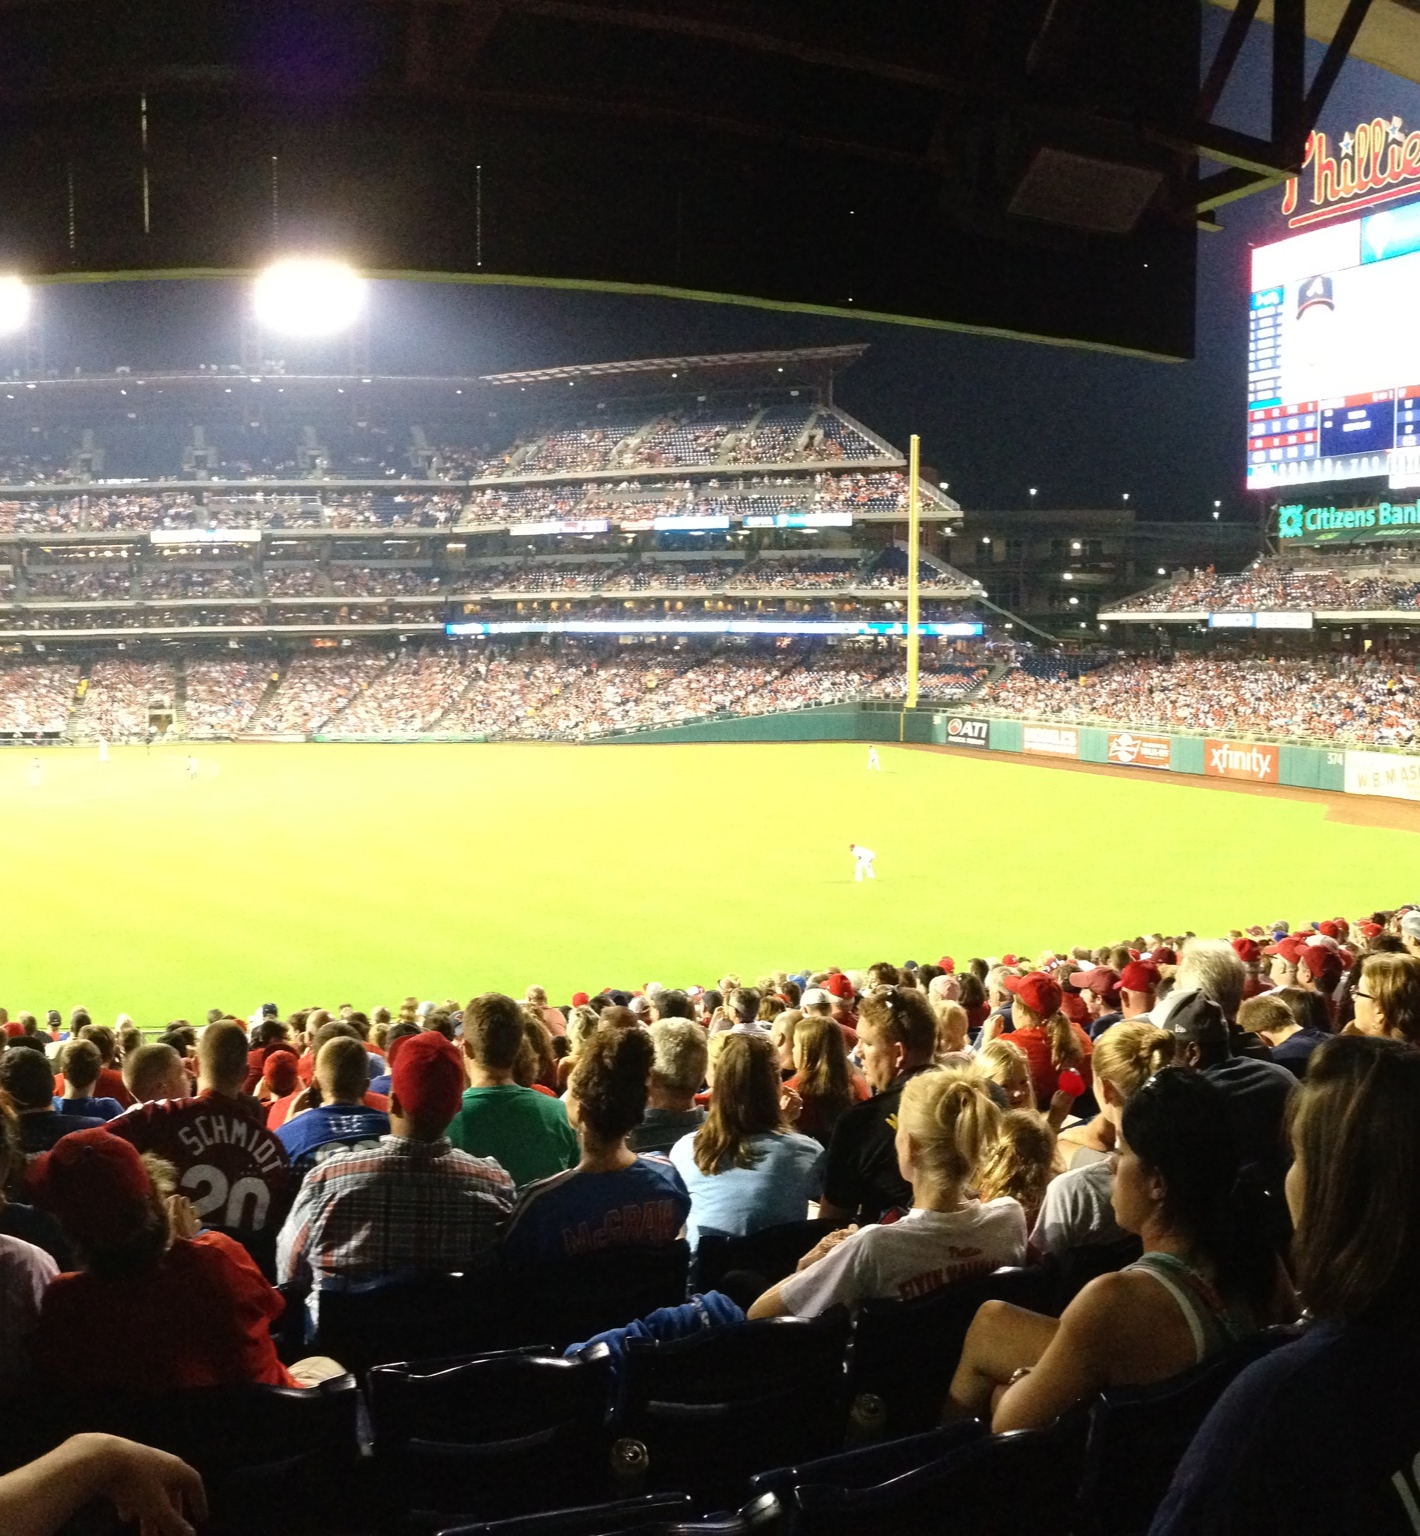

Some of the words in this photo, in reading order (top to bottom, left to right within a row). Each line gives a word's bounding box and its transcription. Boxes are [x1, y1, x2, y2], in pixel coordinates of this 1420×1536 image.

[1305, 506, 1376, 530] Citizens
[960, 720, 987, 739] ATI
[1327, 751, 1344, 767] 374
[329, 1114, 384, 1133] LEE
[178, 1114, 283, 1173] SCHMIDT
[181, 1164, 271, 1231] 20
